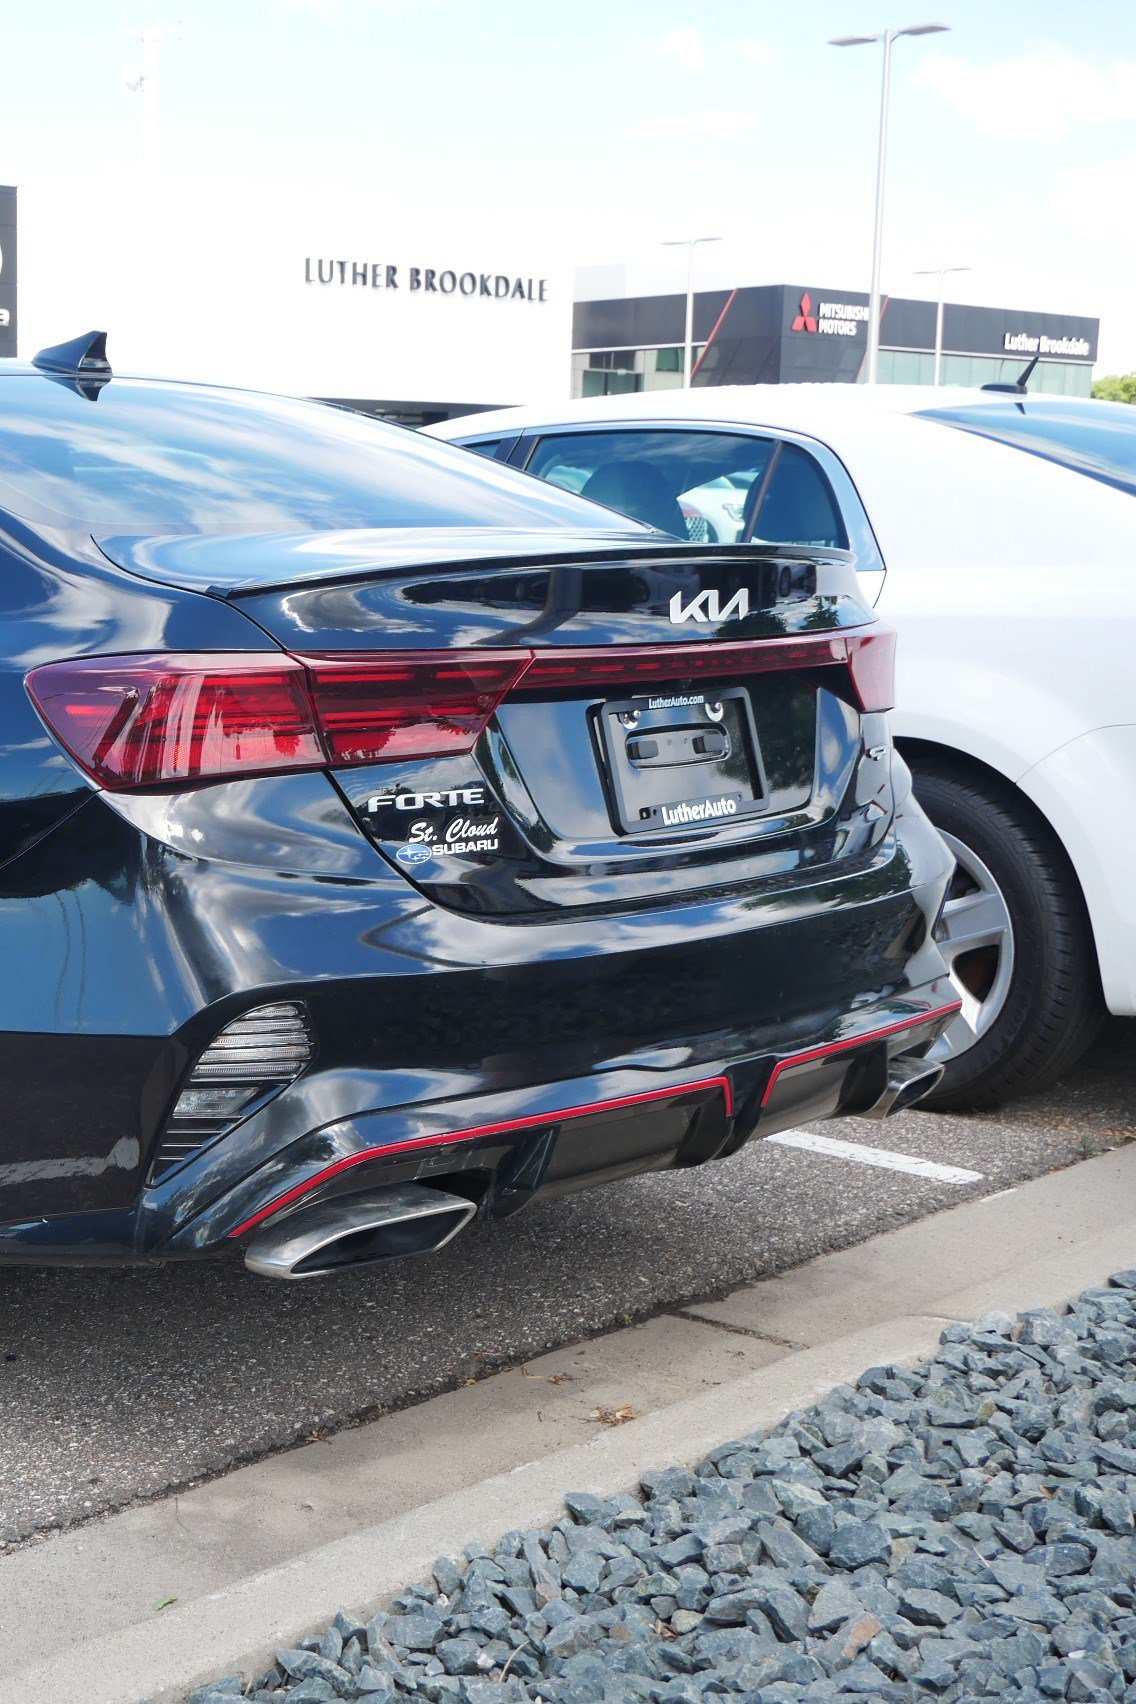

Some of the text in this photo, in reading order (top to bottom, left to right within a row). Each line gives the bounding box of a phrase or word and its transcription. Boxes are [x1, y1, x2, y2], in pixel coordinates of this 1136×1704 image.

[305, 257, 549, 301] LUTHER BROOKDALE
[818, 319, 857, 335] MOTORS
[1004, 332, 1090, 356] Luther Brookdale
[670, 588, 748, 624] KIA
[648, 695, 704, 709] LutherAuto.com
[367, 788, 484, 813] FORTE
[661, 797, 737, 826] LutherAuto
[409, 816, 499, 843] St. Cloud
[432, 838, 499, 856] SUBARU
